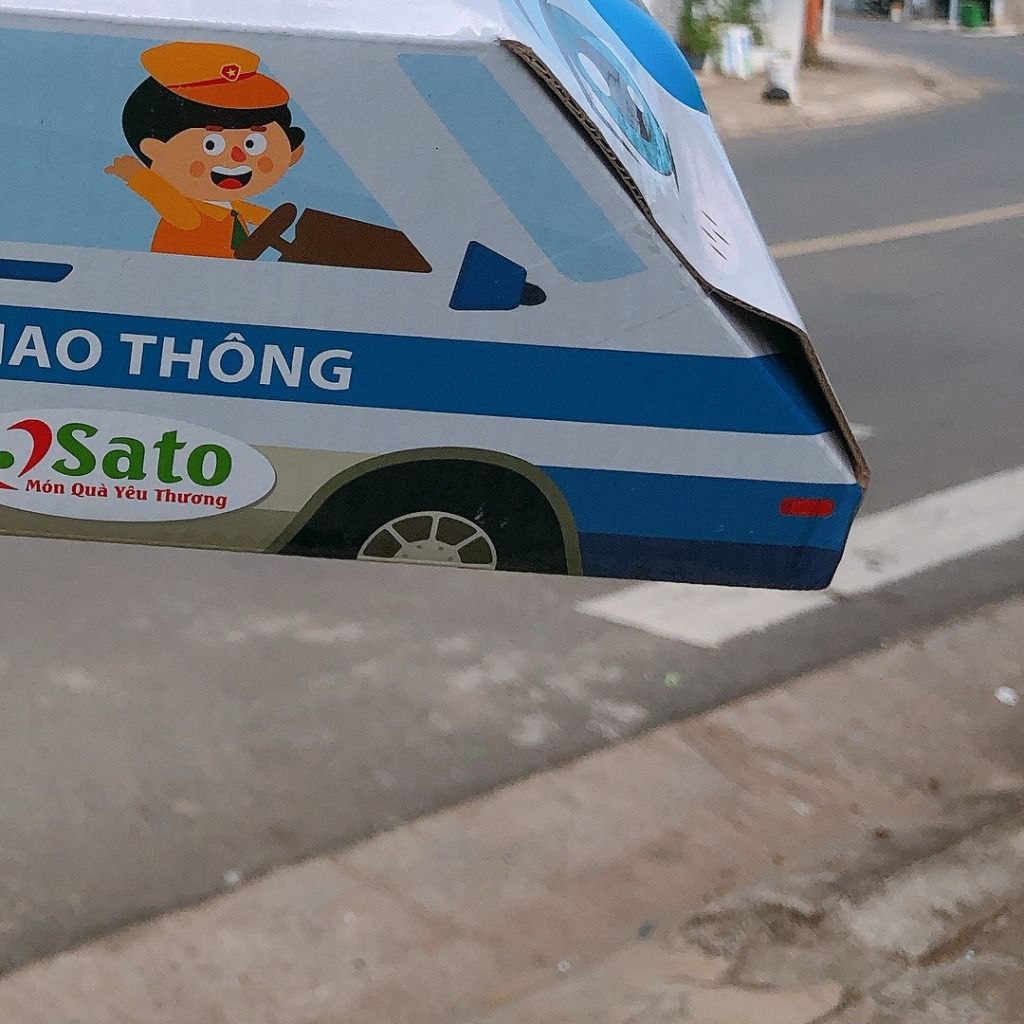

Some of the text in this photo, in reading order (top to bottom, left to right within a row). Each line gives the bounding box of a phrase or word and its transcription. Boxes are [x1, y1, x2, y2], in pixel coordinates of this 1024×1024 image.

[120, 331, 355, 392] THÔNG
[51, 422, 232, 487] Sato
[25, 479, 228, 509] Món Quà Yêu Thương
